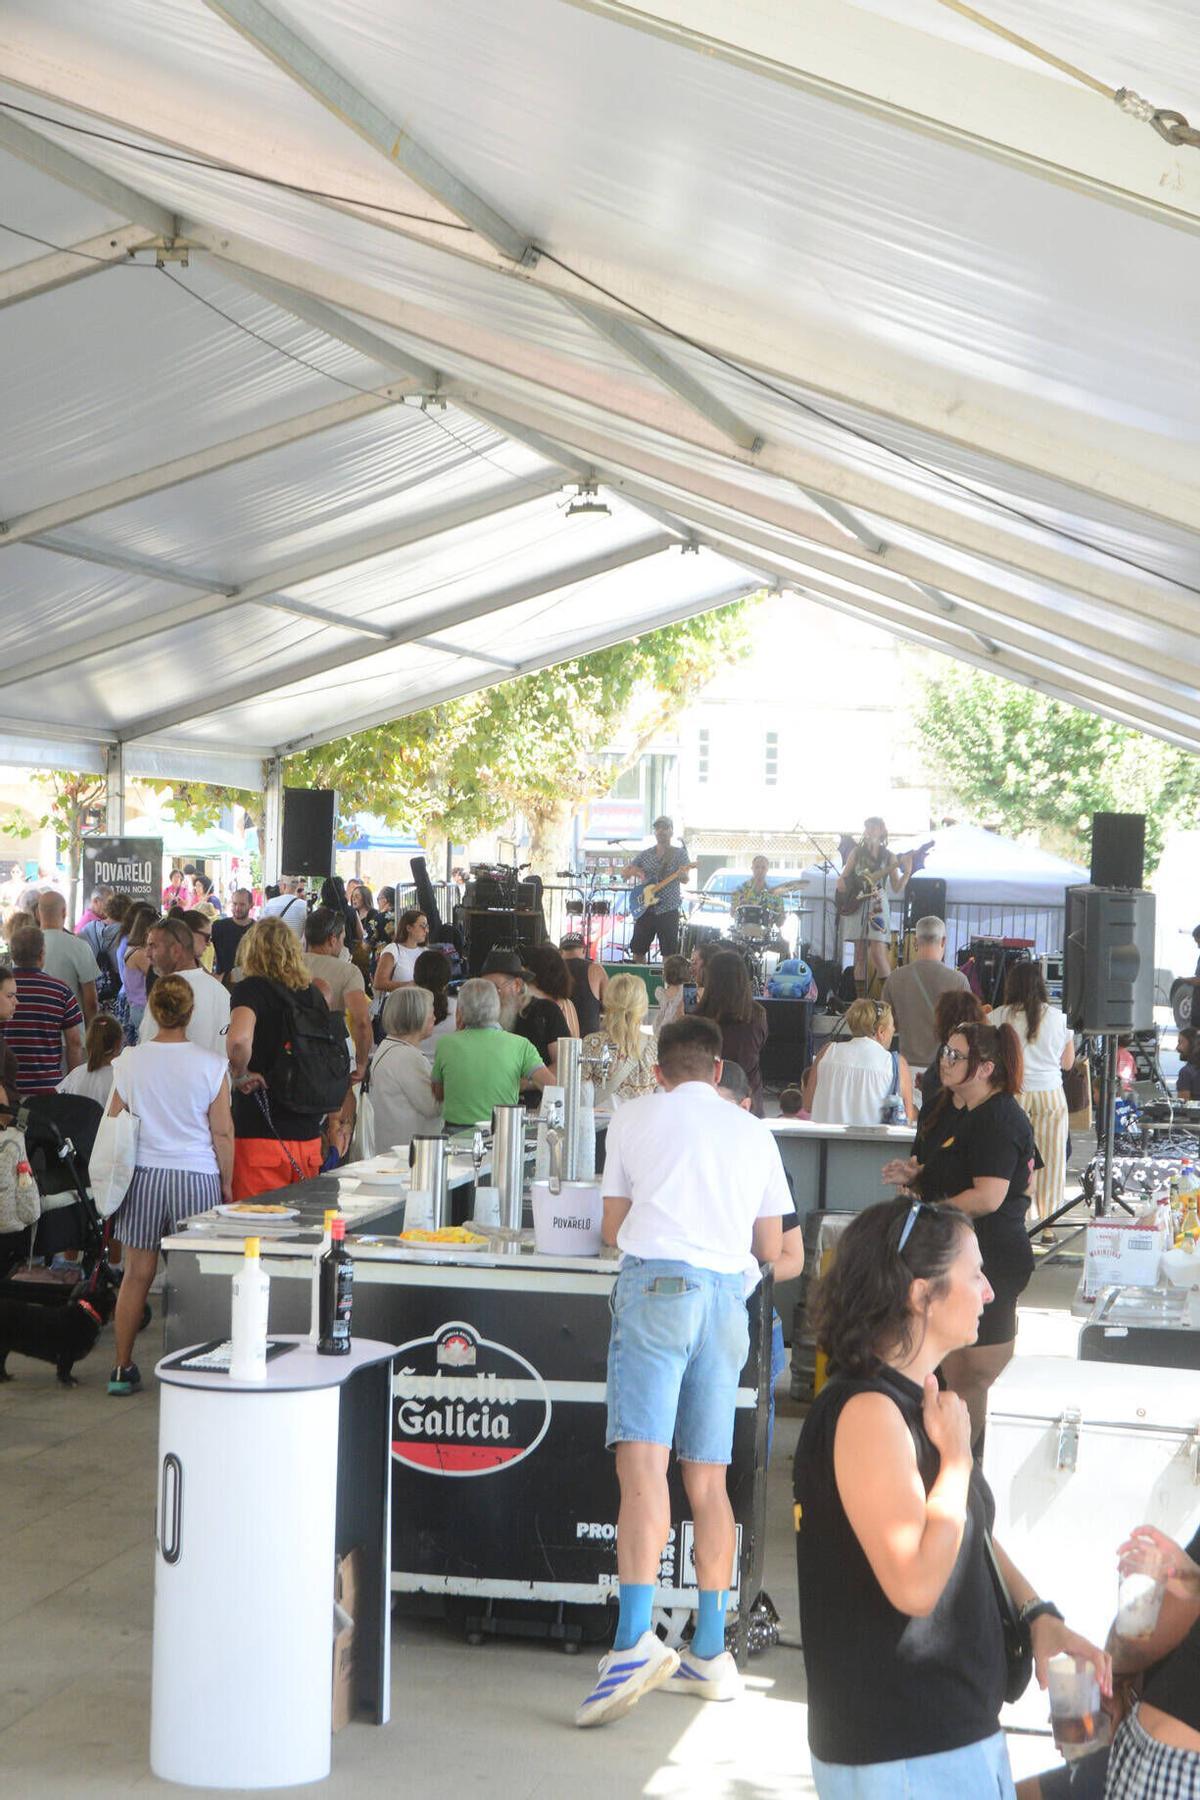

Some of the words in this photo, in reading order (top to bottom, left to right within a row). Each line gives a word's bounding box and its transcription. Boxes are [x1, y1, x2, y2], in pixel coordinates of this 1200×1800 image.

[95, 861, 152, 884] POVARELO
[132, 886, 152, 894] NOSO
[553, 1216, 591, 1230] POVARELO
[398, 1400, 511, 1440] Galicia
